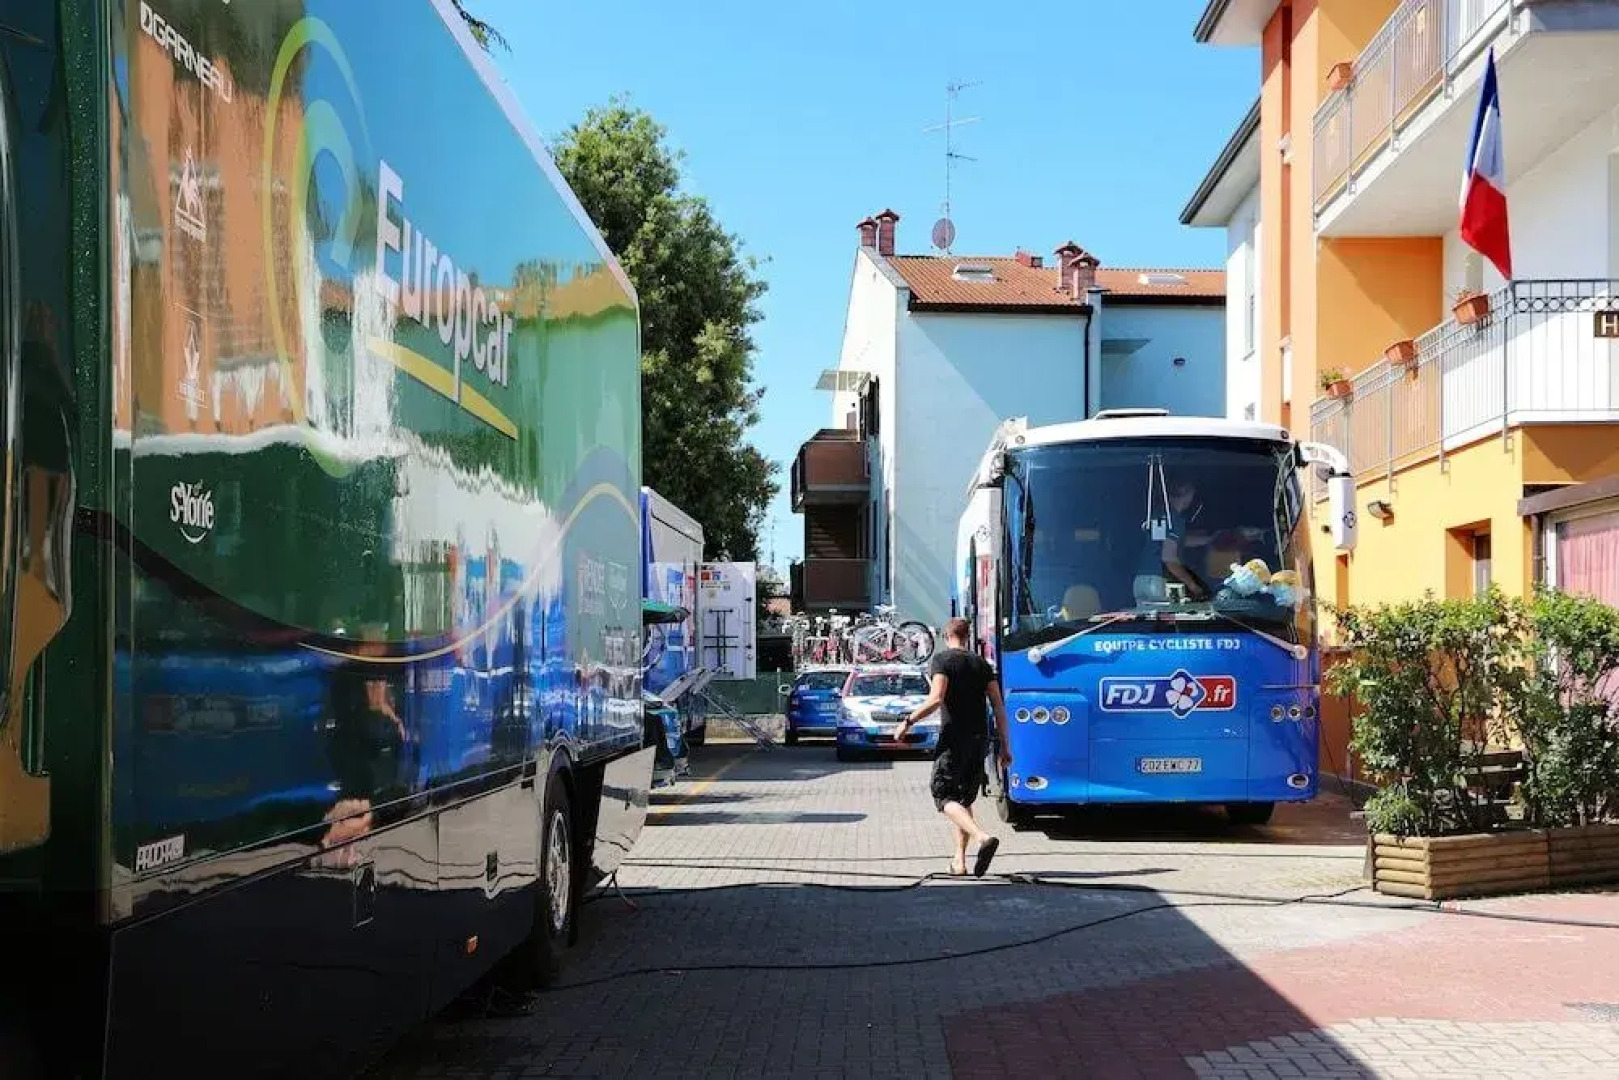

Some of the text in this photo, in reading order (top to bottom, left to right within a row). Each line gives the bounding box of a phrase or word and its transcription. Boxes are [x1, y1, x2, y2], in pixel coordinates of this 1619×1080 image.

[376, 159, 512, 404] Europcar
[1095, 639, 1241, 653] EQUIPE CYCLISTE FDJ
[1106, 684, 1156, 705] FDJ
